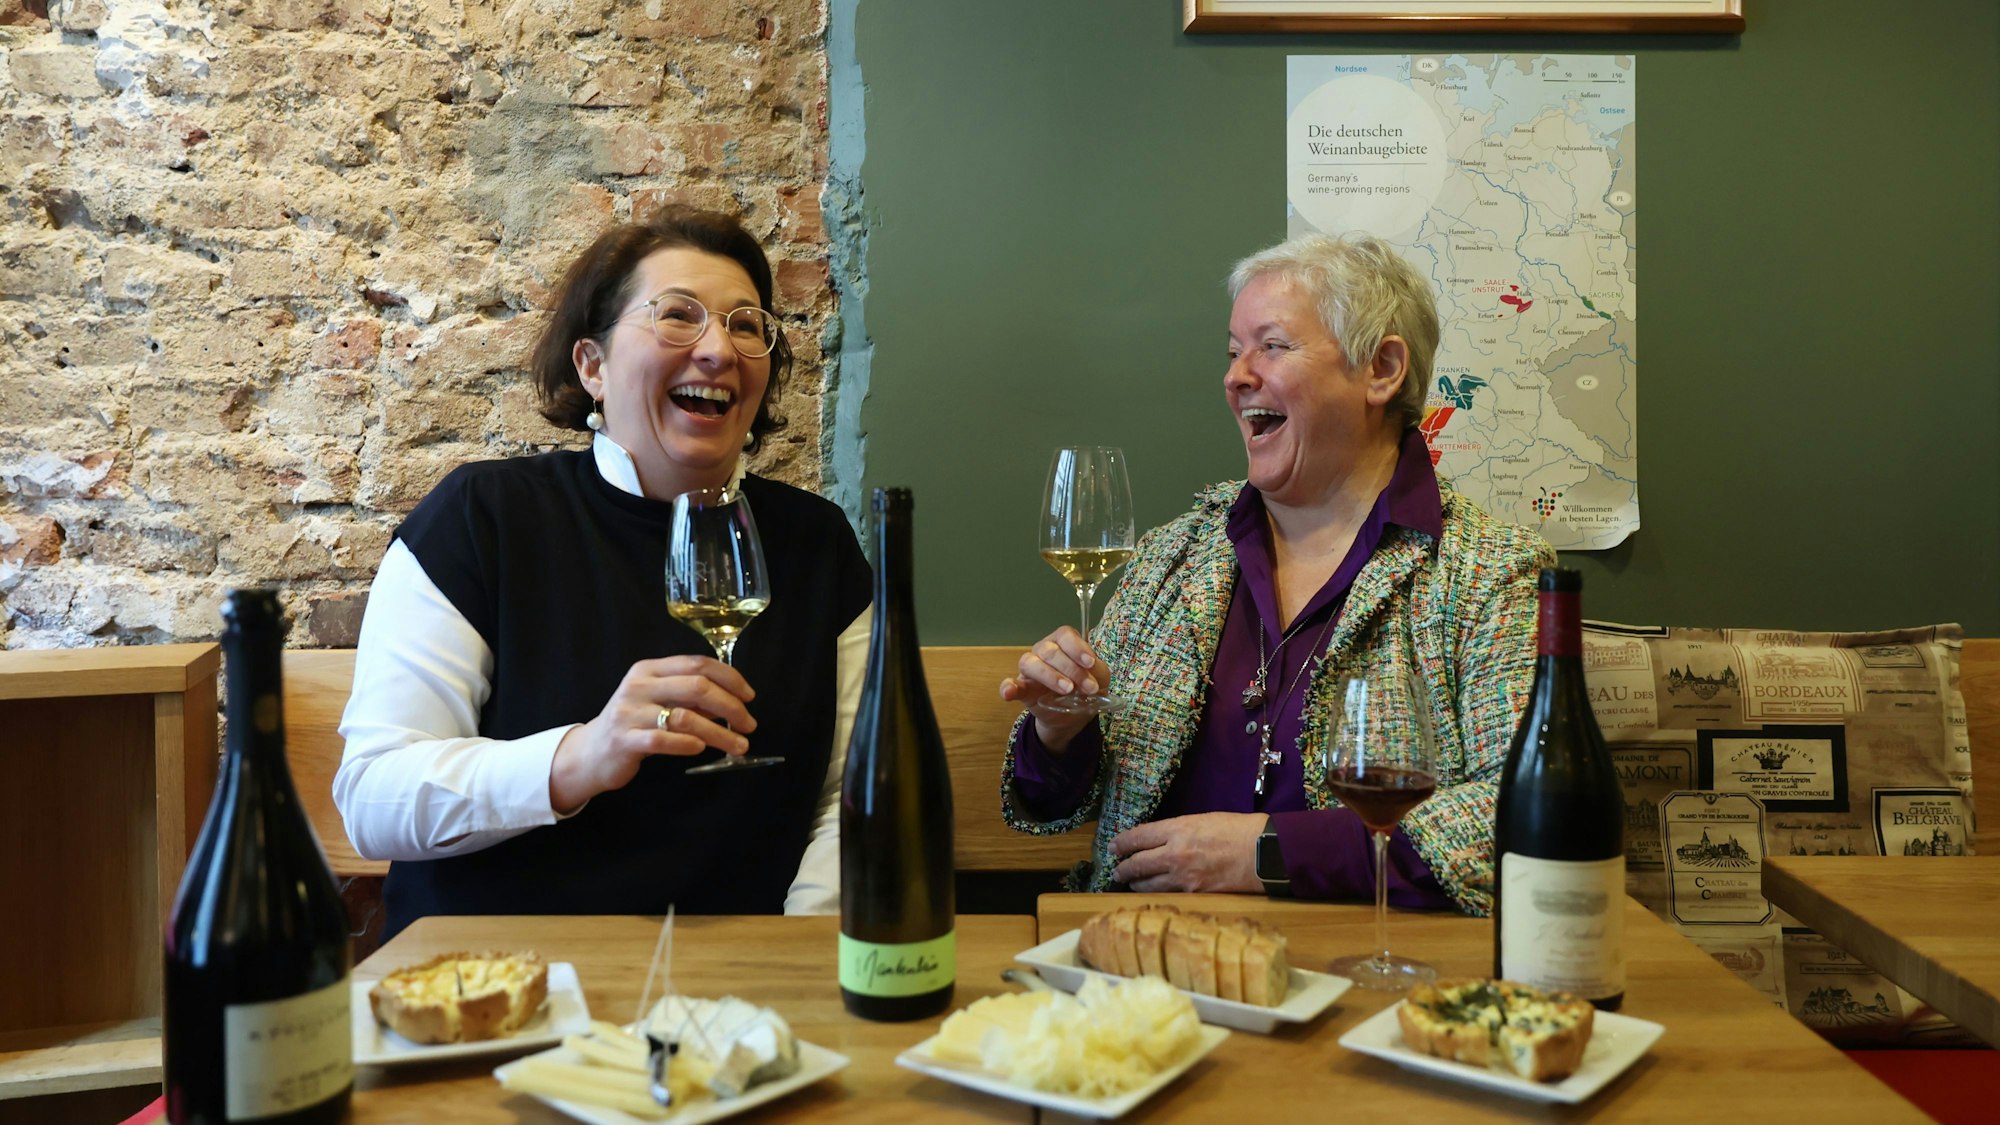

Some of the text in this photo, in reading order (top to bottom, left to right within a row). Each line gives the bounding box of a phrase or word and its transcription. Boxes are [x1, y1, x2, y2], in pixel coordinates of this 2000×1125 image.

[1308, 124, 1403, 138] Die deutschen
[1308, 142, 1428, 158] Weinanbaugebiete
[1308, 173, 1358, 184] Germany's
[1308, 186, 1410, 196] wine-growing regions
[1498, 408, 1524, 416] Nürnberg
[1562, 504, 1612, 512] Willkommen
[1596, 514, 1622, 524] Lagen.
[1634, 691, 1654, 700] DES
[1754, 686, 1848, 698] BORDEAUX
[1731, 742, 1773, 762] CHATEAU
[1740, 773, 1811, 786] Cabernet Sauvignon
[1893, 812, 1962, 825] BELGRAVE
